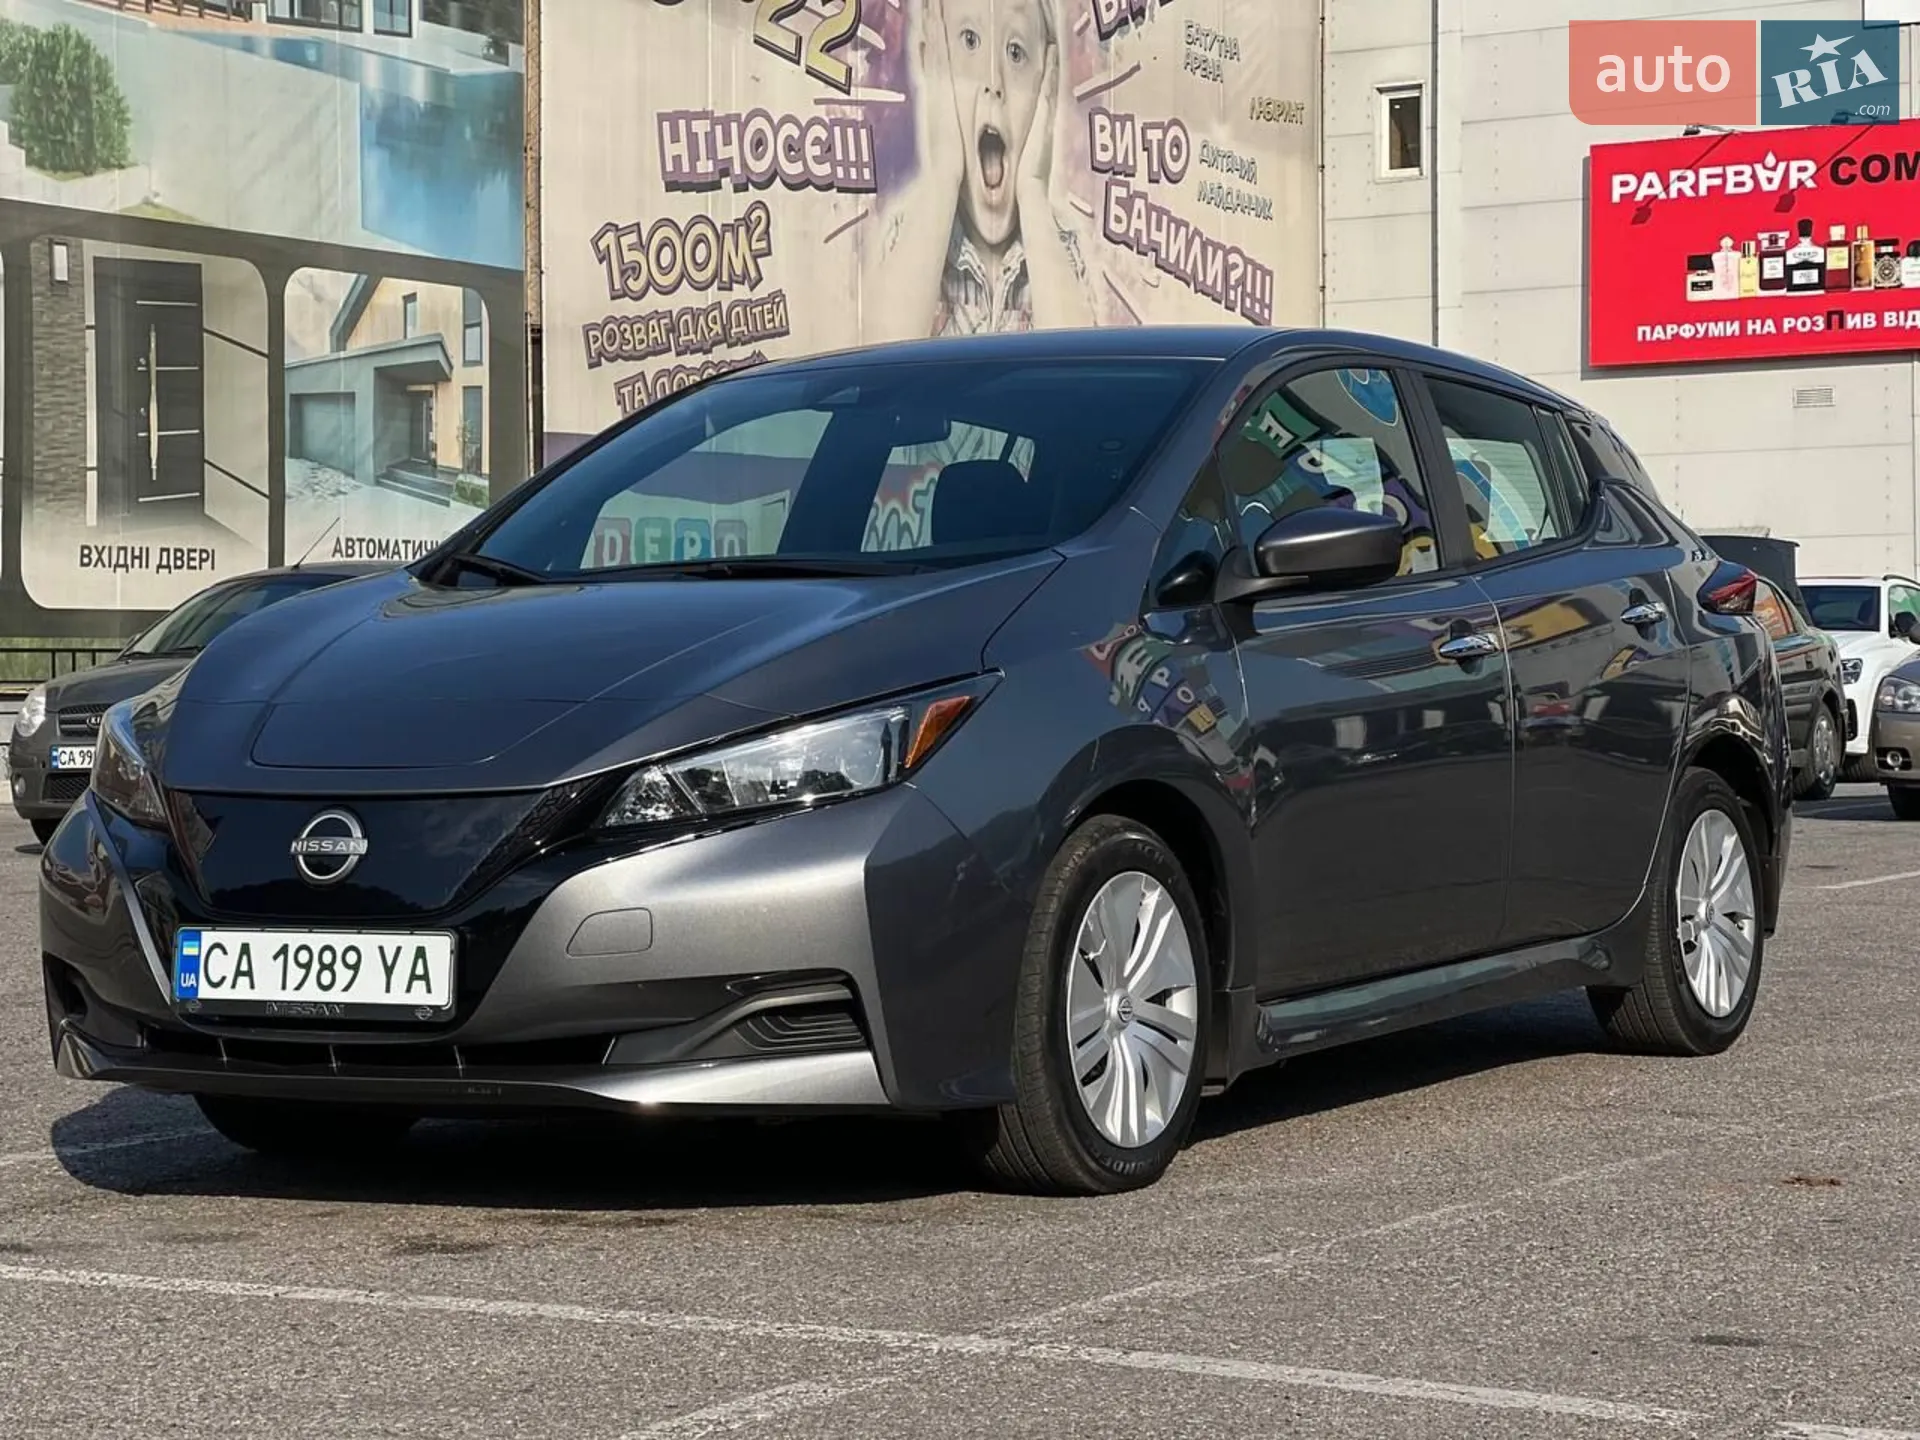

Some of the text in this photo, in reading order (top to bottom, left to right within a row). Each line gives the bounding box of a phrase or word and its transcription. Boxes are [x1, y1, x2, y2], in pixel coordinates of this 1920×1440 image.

[659, 111, 875, 190] НІЧОСЄ!!!
[1091, 109, 1189, 183] ВИ ТО
[1611, 153, 1818, 203] PARFBAR
[584, 292, 788, 366] РОЗВАГ ДЛЯ ДІТЕЙ
[1637, 320, 1740, 342] ПАРФУМИ
[1747, 317, 1777, 335] НА
[1783, 310, 1877, 333] РОЗПИВ
[79, 544, 216, 575] ВХІДНІ ДВЕРІ
[332, 536, 439, 560] АВТОМАТИЧ
[59, 749, 96, 766] CA 99
[290, 840, 364, 853] NISSAN
[181, 972, 197, 988] UA
[203, 942, 433, 994] CA 1989 YA
